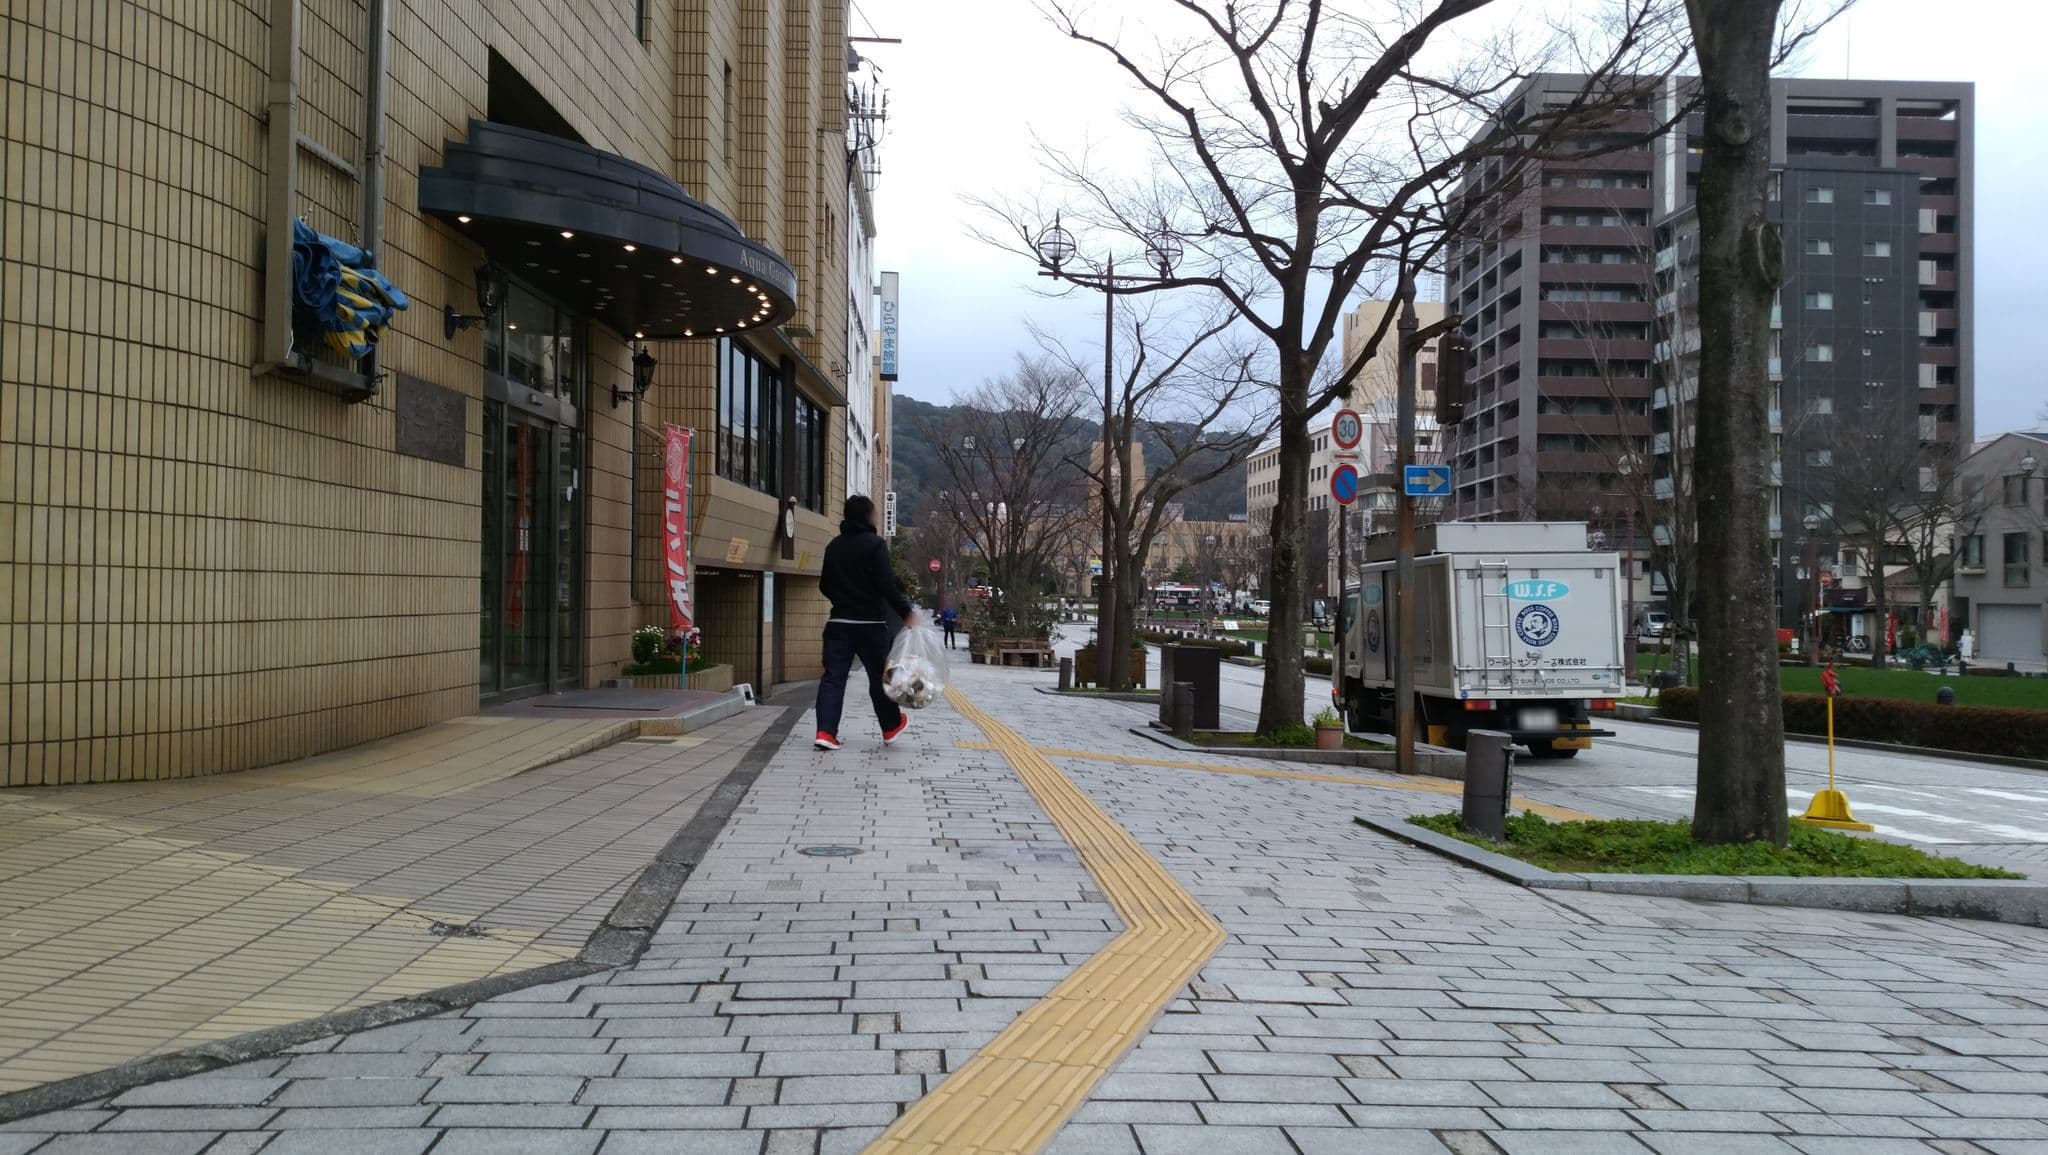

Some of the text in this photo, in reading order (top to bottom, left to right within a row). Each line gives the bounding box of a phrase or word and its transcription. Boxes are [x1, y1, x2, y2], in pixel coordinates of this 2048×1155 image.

[740, 248, 767, 274] Aqua
[883, 301, 896, 374] ひらやま旅館
[1339, 419, 1356, 438] 30
[1514, 583, 1557, 598] W.S.F
